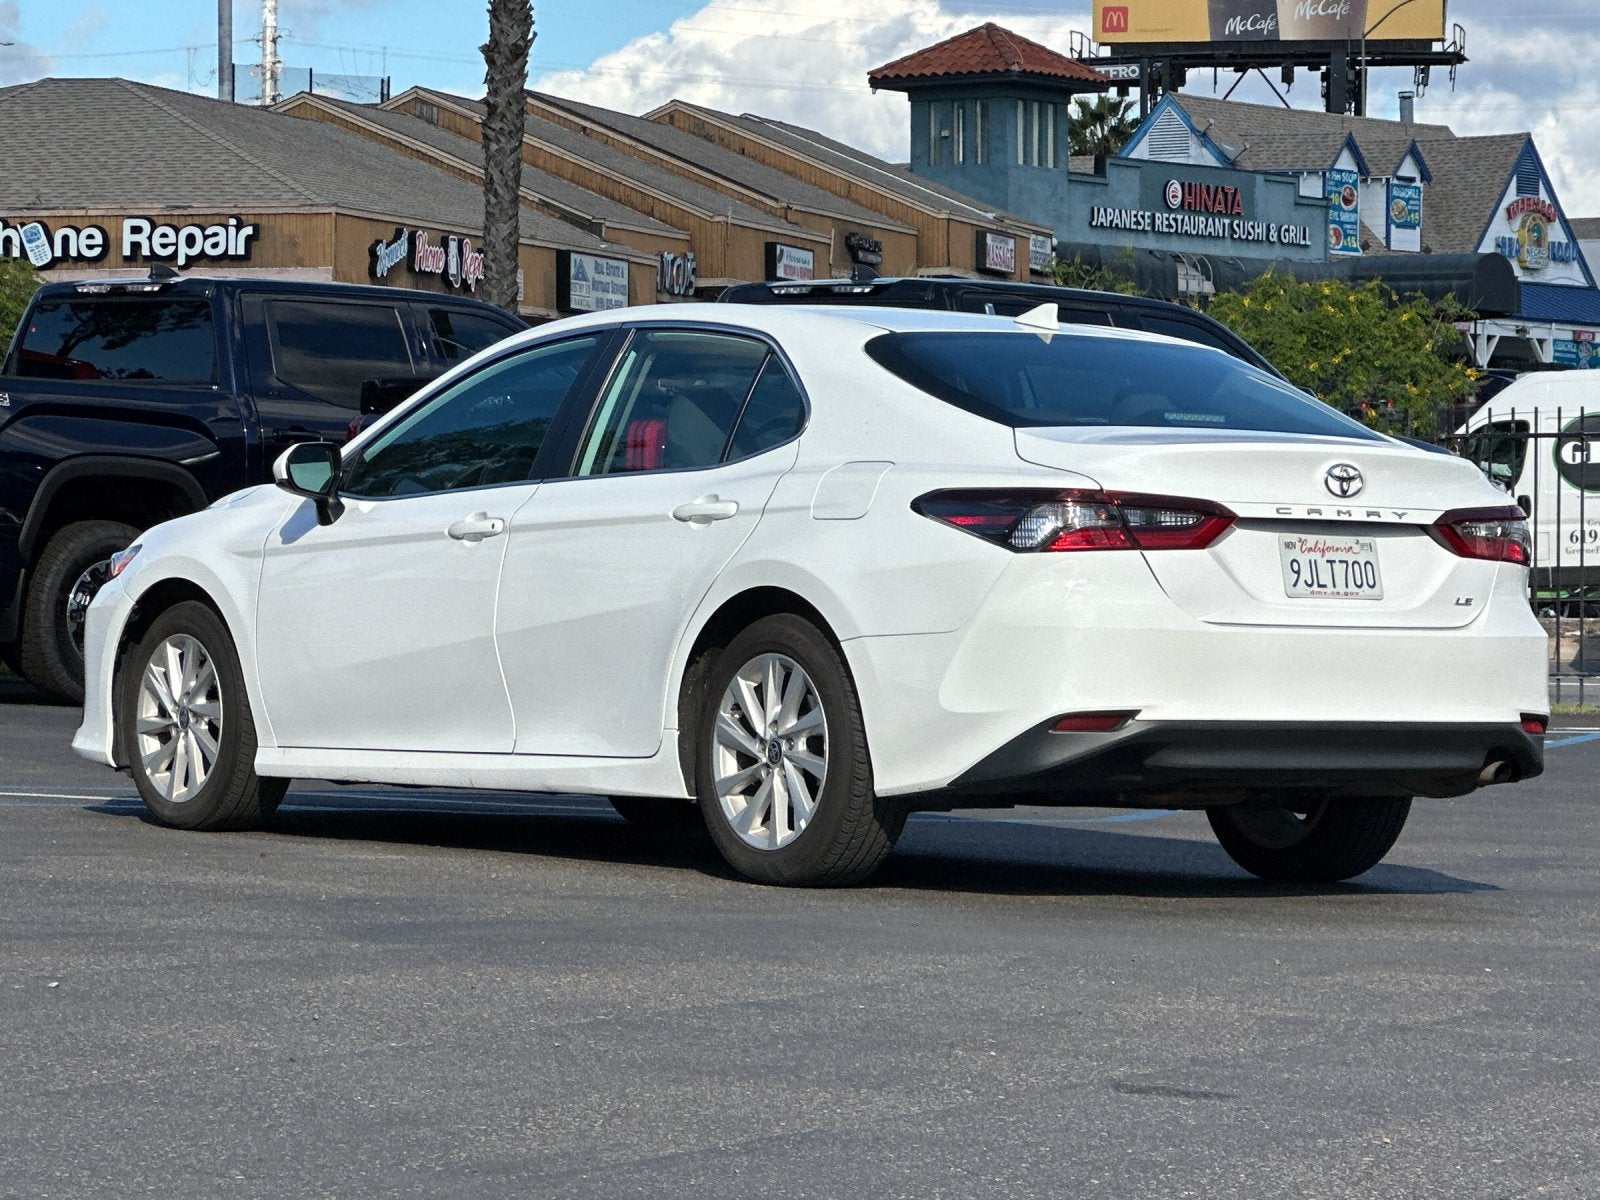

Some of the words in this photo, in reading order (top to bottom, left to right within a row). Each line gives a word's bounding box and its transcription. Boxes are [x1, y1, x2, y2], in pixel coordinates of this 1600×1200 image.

[1225, 13, 1277, 35] McCafé
[1183, 182, 1244, 215] HINATA
[1092, 206, 1151, 231] JAPANESE
[1154, 212, 1230, 238] RESTAURANT
[1233, 220, 1266, 241] SUSHI
[1269, 223, 1278, 242] &
[1280, 224, 1312, 246] GRILL
[122, 218, 253, 266] Repair
[415, 230, 446, 274] Phone
[1275, 507, 1409, 520] CAMRY
[1300, 538, 1360, 558] California
[1290, 558, 1377, 589] 9JLT700
[1454, 597, 1474, 607] LE
